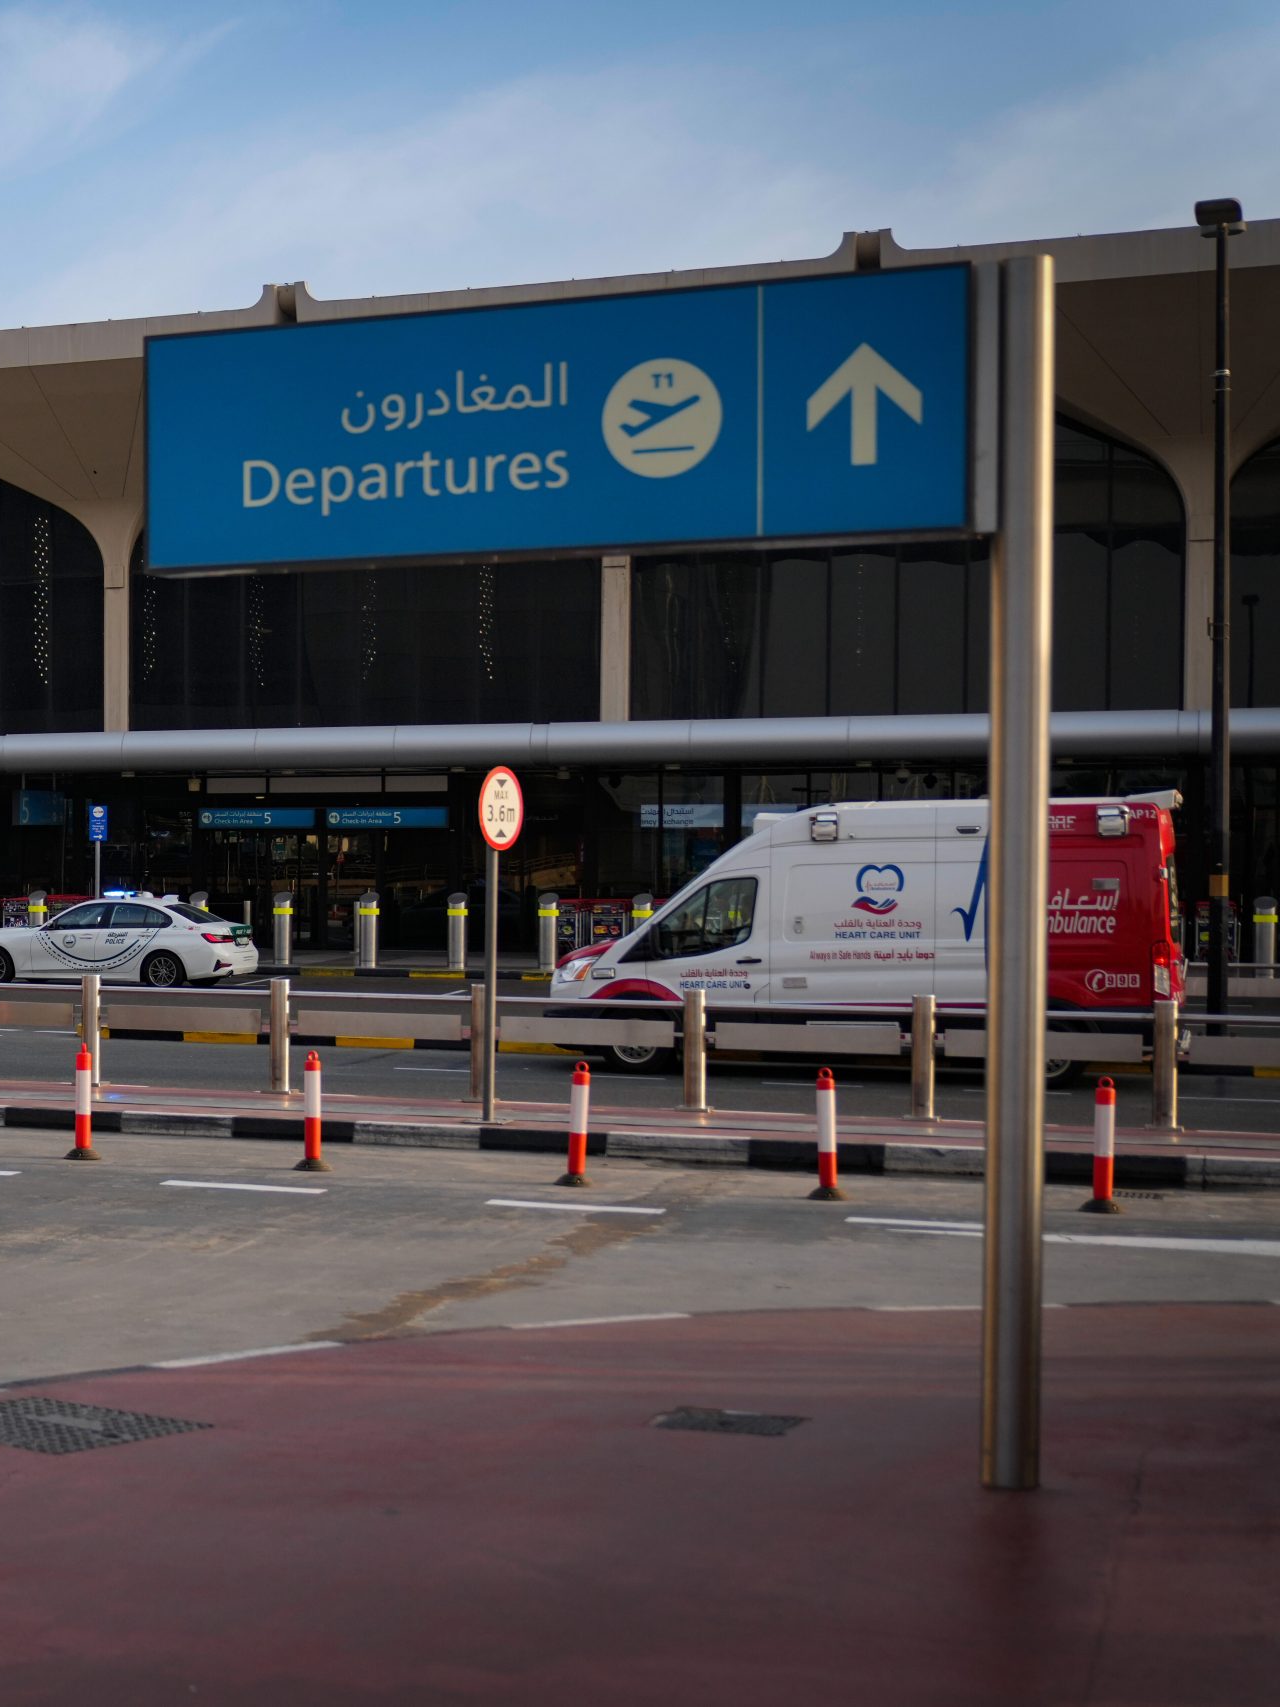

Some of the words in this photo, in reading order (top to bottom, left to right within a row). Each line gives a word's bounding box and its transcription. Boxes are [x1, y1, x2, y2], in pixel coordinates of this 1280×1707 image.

[651, 372, 674, 389] T1
[340, 361, 568, 434] المغادرون
[242, 448, 570, 516] Departures
[264, 812, 272, 824] 5
[393, 811, 401, 824] 5
[487, 804, 515, 823] 3.6m
[834, 919, 863, 930] بالقلب
[866, 919, 895, 930] العناية
[897, 919, 922, 930] وحدة
[1047, 910, 1117, 934] bulance
[835, 931, 867, 939] HEART
[869, 931, 896, 939] CARE
[899, 931, 921, 939] UNIT
[809, 950, 831, 962] Always
[839, 950, 852, 959] Safe
[853, 950, 871, 959] Hands
[680, 980, 703, 989] HEART
[706, 980, 727, 989] CARE
[729, 980, 746, 989] UNIT
[1107, 974, 1138, 987] 998
